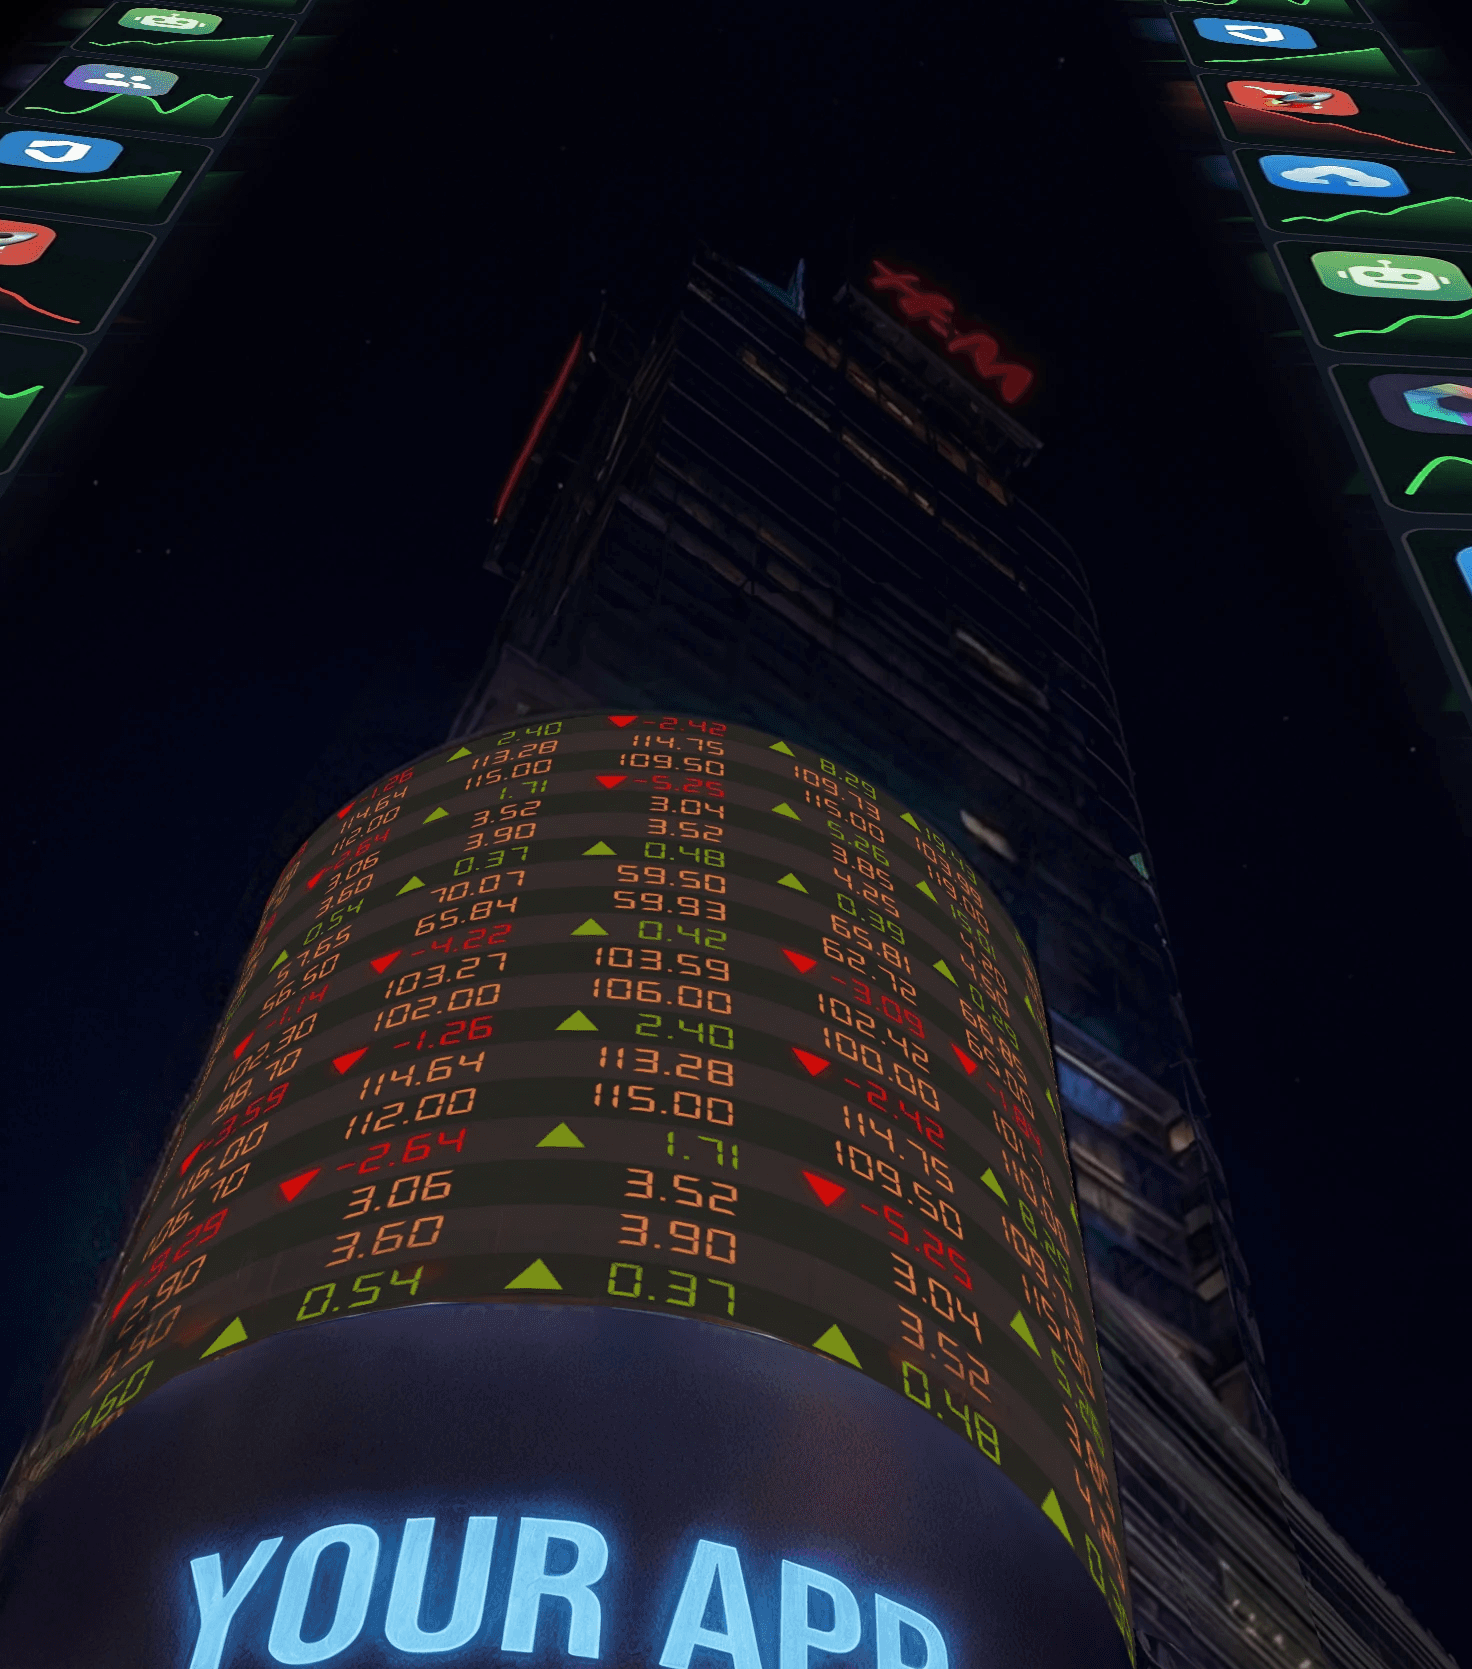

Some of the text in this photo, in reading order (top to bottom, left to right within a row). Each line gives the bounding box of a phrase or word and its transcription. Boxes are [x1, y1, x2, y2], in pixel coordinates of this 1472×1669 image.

[496, 720, 564, 747] 2.40
[632, 733, 726, 757] 114.75
[642, 716, 728, 738] -2.42
[464, 757, 554, 792] 115.00
[471, 738, 559, 771] 113.28
[619, 752, 726, 778] 109.50
[819, 757, 878, 801] 8.29
[338, 785, 409, 835] 114.64
[632, 773, 726, 799] -5.25
[648, 795, 726, 821] 3.04
[793, 764, 882, 822] 109.73
[330, 805, 402, 857] 112.00
[462, 821, 538, 853] 3.90
[470, 799, 543, 830] 3.52
[646, 817, 725, 845] 3.52
[804, 789, 886, 844] 115.00
[452, 844, 530, 878] 0.37
[643, 840, 727, 869] 0.48
[826, 819, 890, 868] 5.26
[829, 841, 895, 892] 3.85
[314, 872, 375, 920] 3.60
[324, 850, 382, 896] 3.06
[429, 869, 527, 905] 70.07
[616, 863, 727, 896] 59.50
[832, 866, 901, 919] 4.25
[302, 897, 366, 948] 0.54
[413, 895, 520, 938] 65.84
[612, 889, 728, 923] 59.93
[835, 891, 907, 946] 0.39
[926, 863, 991, 936] 119.00
[409, 922, 513, 959] -4.22
[637, 919, 728, 952] 0.42
[829, 912, 913, 976] 65.81
[257, 953, 342, 1022] 56.50
[383, 951, 509, 1001] 103.27
[594, 945, 731, 983] 103.59
[821, 935, 919, 1007] 62.72
[373, 982, 502, 1033] 102.00
[592, 976, 733, 1016] 106.00
[830, 973, 926, 1040] -3.09
[222, 1011, 318, 1093] 102.30
[392, 1014, 495, 1052] -1.26
[634, 1012, 735, 1051] 2.40
[817, 992, 930, 1073] 102.42
[959, 997, 1028, 1086] 66.85
[359, 1050, 487, 1102] 114.64
[598, 1044, 735, 1088] 113.28
[822, 1025, 942, 1113] 100.00
[965, 1027, 1036, 1122] 65.00
[344, 1086, 477, 1141] 112.00
[593, 1081, 735, 1128] 115.00
[843, 1077, 947, 1152] -2.42
[170, 1120, 270, 1211] 116.00
[335, 1126, 468, 1176] -2.64
[841, 1104, 955, 1195] 114.75
[341, 1168, 455, 1221] 3.06
[623, 1167, 739, 1217] 3.52
[835, 1139, 965, 1241] 109.50
[323, 1214, 446, 1269] 3.60
[616, 1212, 738, 1266] 3.90
[859, 1202, 974, 1291] -5.25
[294, 1265, 425, 1323] 0.54
[606, 1260, 736, 1318] 0.37
[889, 1250, 984, 1346] 3.04
[896, 1302, 993, 1405] 3.52
[901, 1358, 1003, 1467] 0.48
